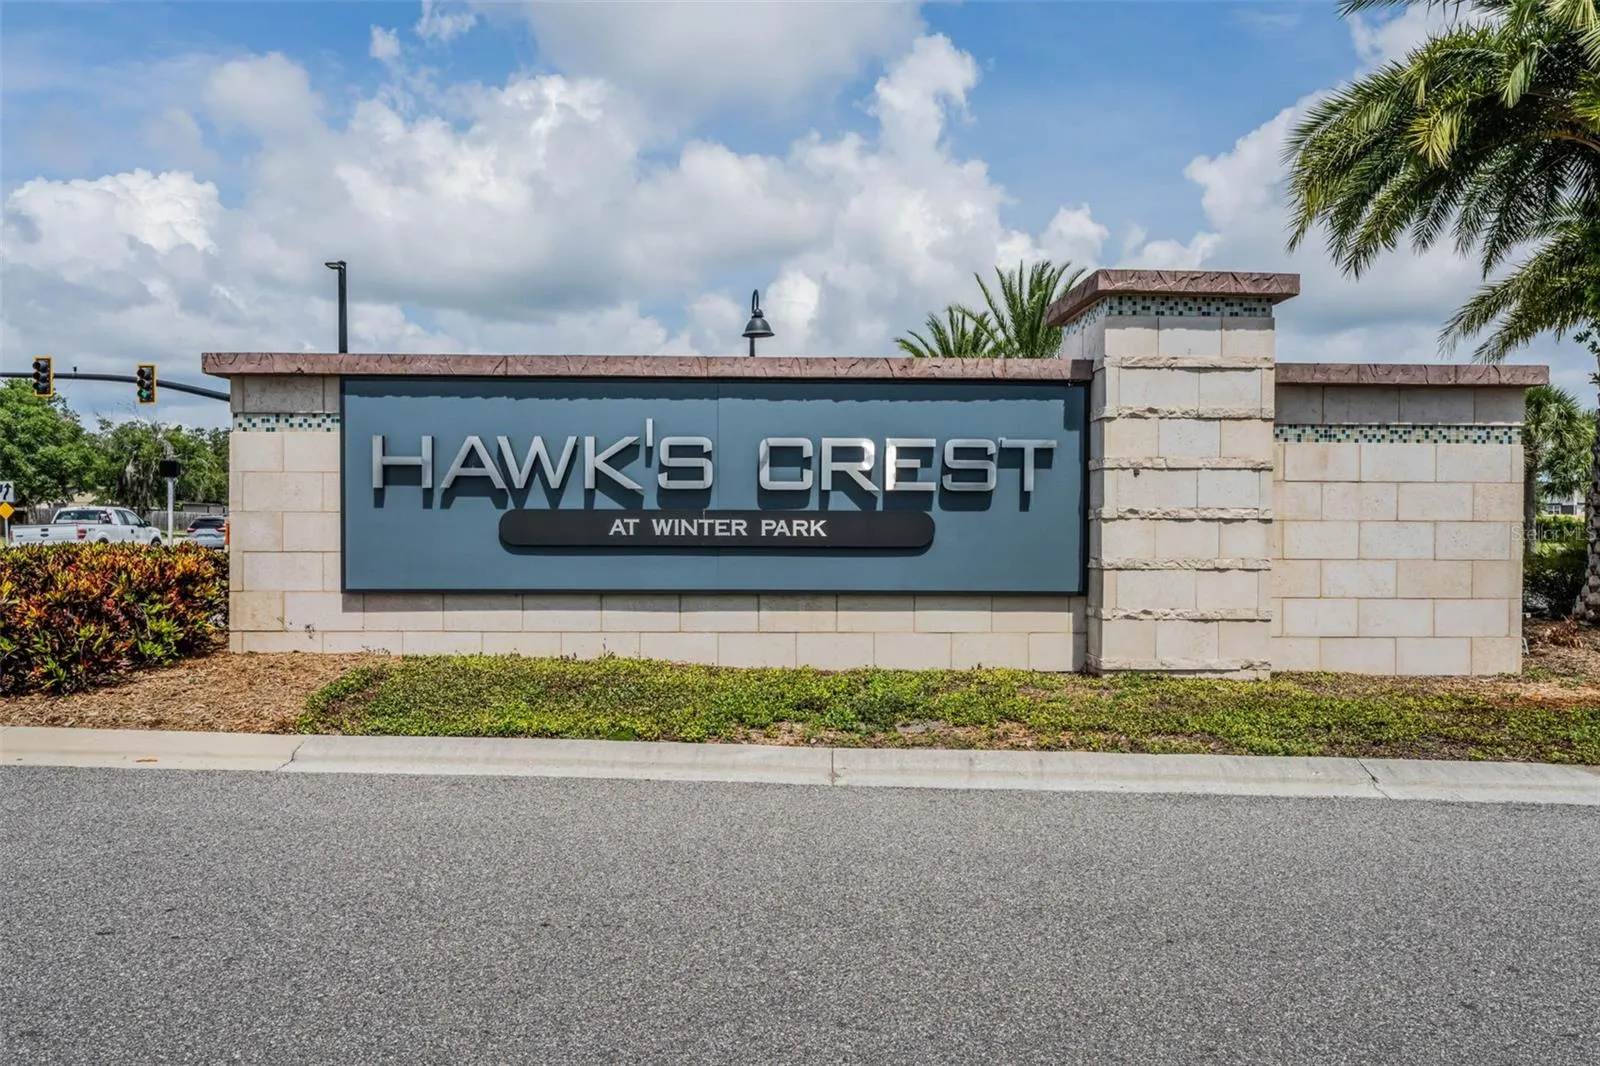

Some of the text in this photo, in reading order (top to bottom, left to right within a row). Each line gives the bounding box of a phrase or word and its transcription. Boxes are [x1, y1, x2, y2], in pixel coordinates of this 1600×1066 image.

[372, 418, 1057, 492] HAWK'S CREST
[608, 519, 828, 537] AT WINTER PARK
